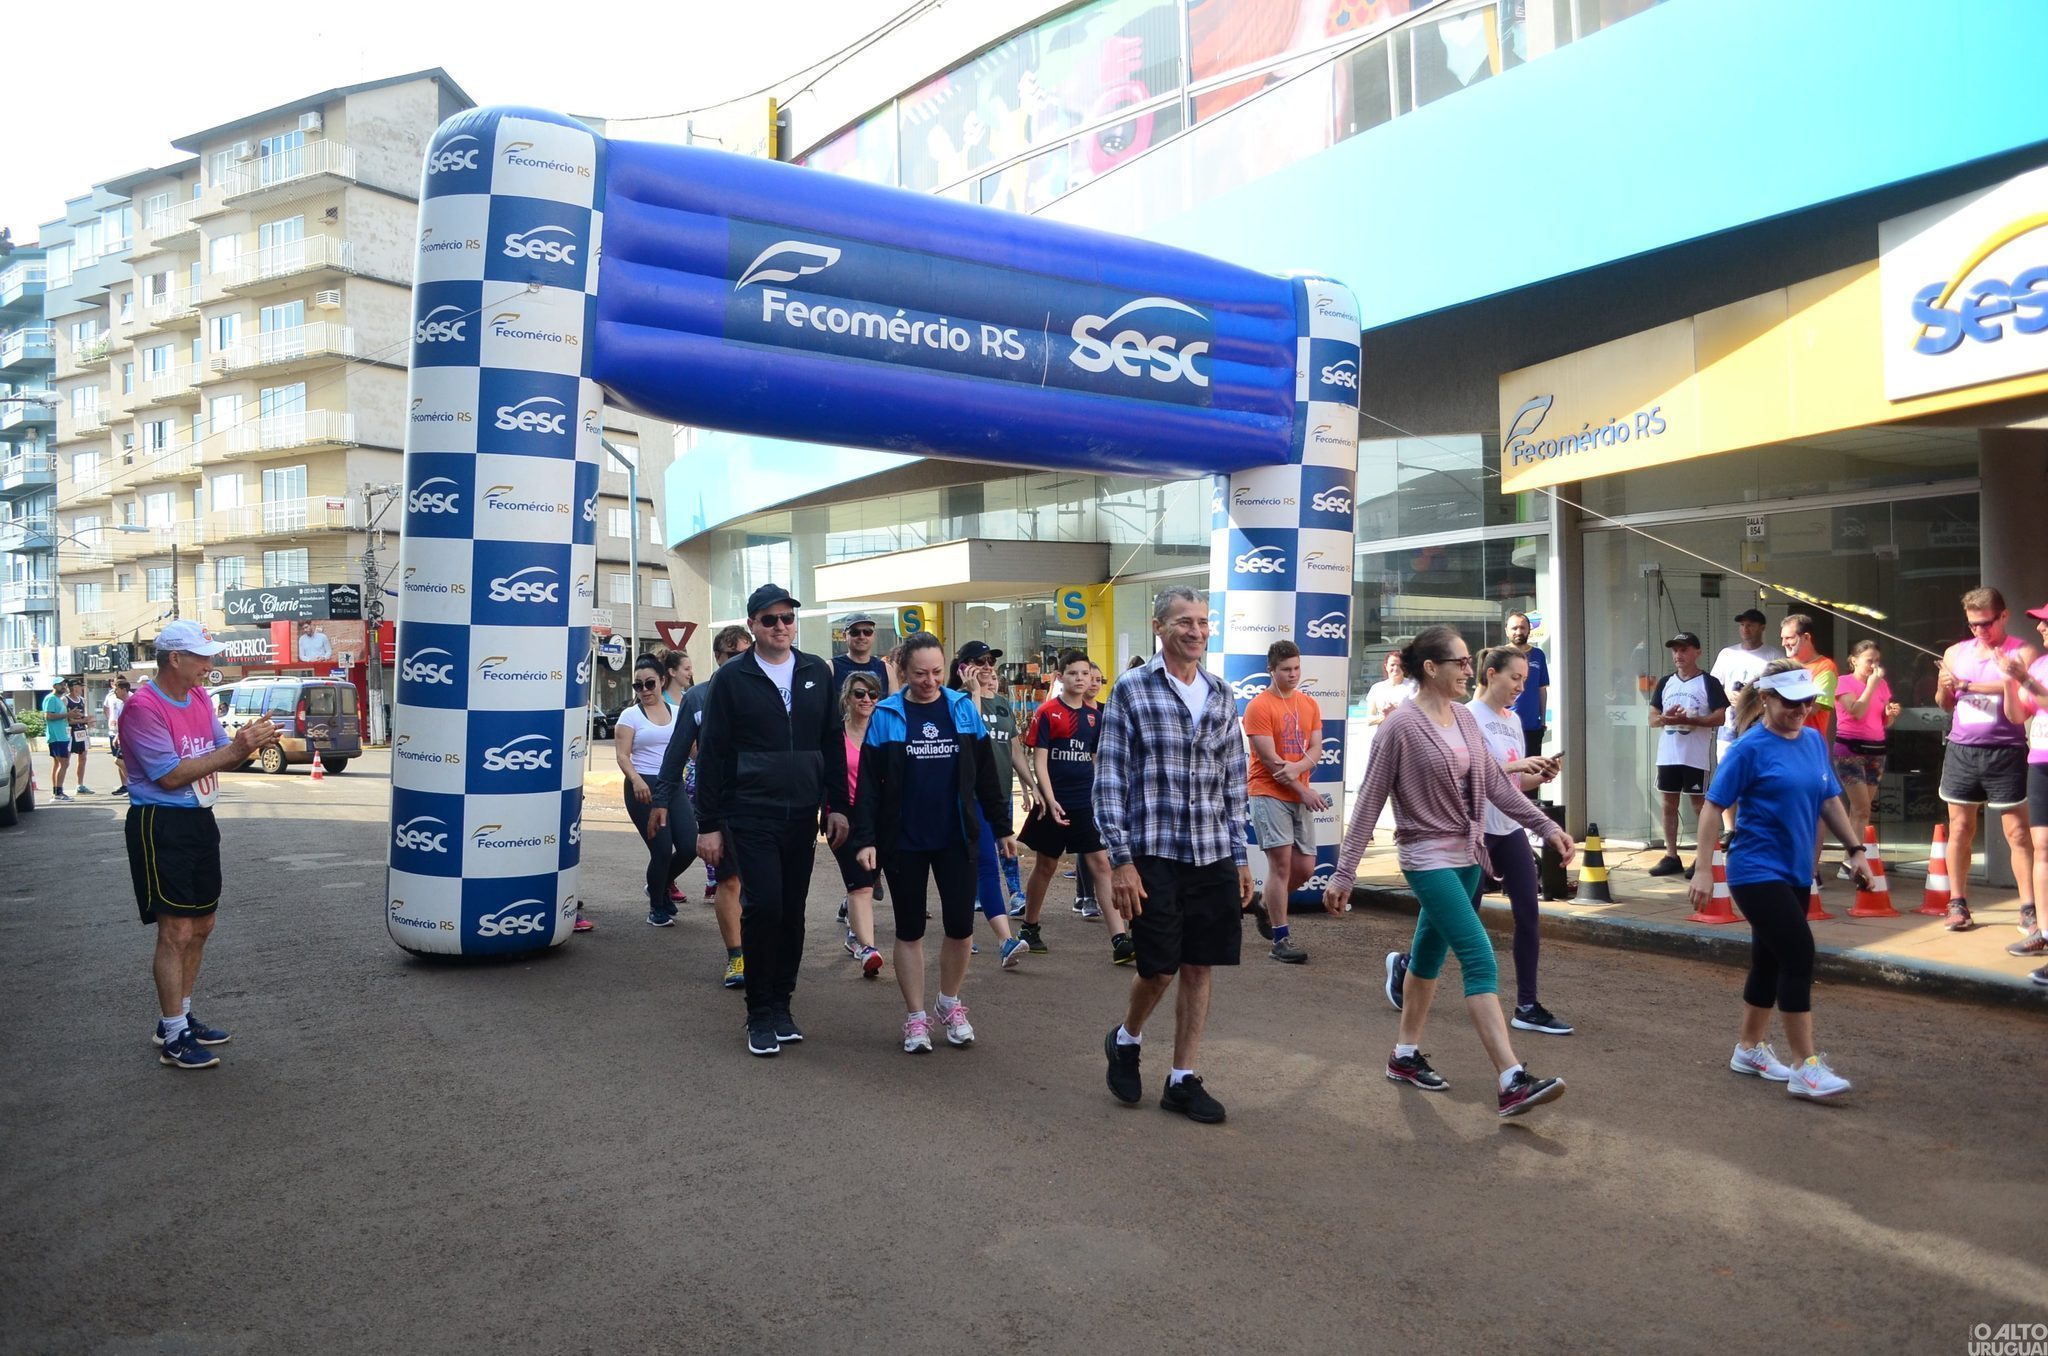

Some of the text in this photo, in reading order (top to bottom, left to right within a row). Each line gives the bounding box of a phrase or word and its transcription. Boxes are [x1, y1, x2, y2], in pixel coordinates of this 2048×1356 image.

[428, 149, 478, 175] Sesc
[508, 155, 590, 178] Fecomércio RS
[466, 239, 480, 251] RS
[503, 234, 576, 265] Sesc
[1911, 265, 2048, 356] Ses
[415, 320, 466, 344] Sesc
[762, 287, 1025, 361] Fecomércio RS
[495, 327, 578, 346] Fecomércio RS
[1069, 314, 1209, 387] Sesc
[1320, 366, 1357, 390] Sesc
[411, 410, 472, 423] Fecomércio RS
[494, 406, 566, 435] Sesc
[1315, 435, 1351, 447] Fecomércio
[1511, 406, 1667, 466] Fecomércio RS
[409, 490, 459, 514] Sesc
[489, 498, 570, 514] Fecomércio RS
[1235, 496, 1295, 506] Fecomércio RS
[1311, 493, 1351, 514] Sesc
[1234, 554, 1286, 574] Sesc
[1307, 562, 1345, 573] Fecomércio
[404, 580, 466, 594] Fecomércio RS
[488, 578, 559, 603] Sesc
[229, 593, 299, 614] Ma Cherie
[1063, 591, 1087, 620] S
[903, 609, 921, 634] S
[1230, 623, 1290, 633] Fecomércio RS
[1306, 619, 1346, 639] Sesc
[225, 638, 267, 658] FREDERICO
[402, 658, 453, 685] Sesc
[483, 669, 563, 681] Fecomércio RS
[1231, 680, 1268, 700] Ses
[1964, 698, 1991, 711] 87
[307, 728, 329, 738] Sesc
[905, 743, 960, 755] Auxiliadora
[1070, 739, 1085, 751] Fly
[396, 748, 460, 764] Fecomércio RS
[482, 747, 552, 771] Sesc
[1317, 749, 1341, 766] esc
[1313, 814, 1335, 824] mércio
[396, 825, 447, 853] Sesc
[477, 835, 556, 849] Fecomércio RS
[391, 910, 455, 931] Fecomércio RS
[477, 912, 545, 937] Sesc
